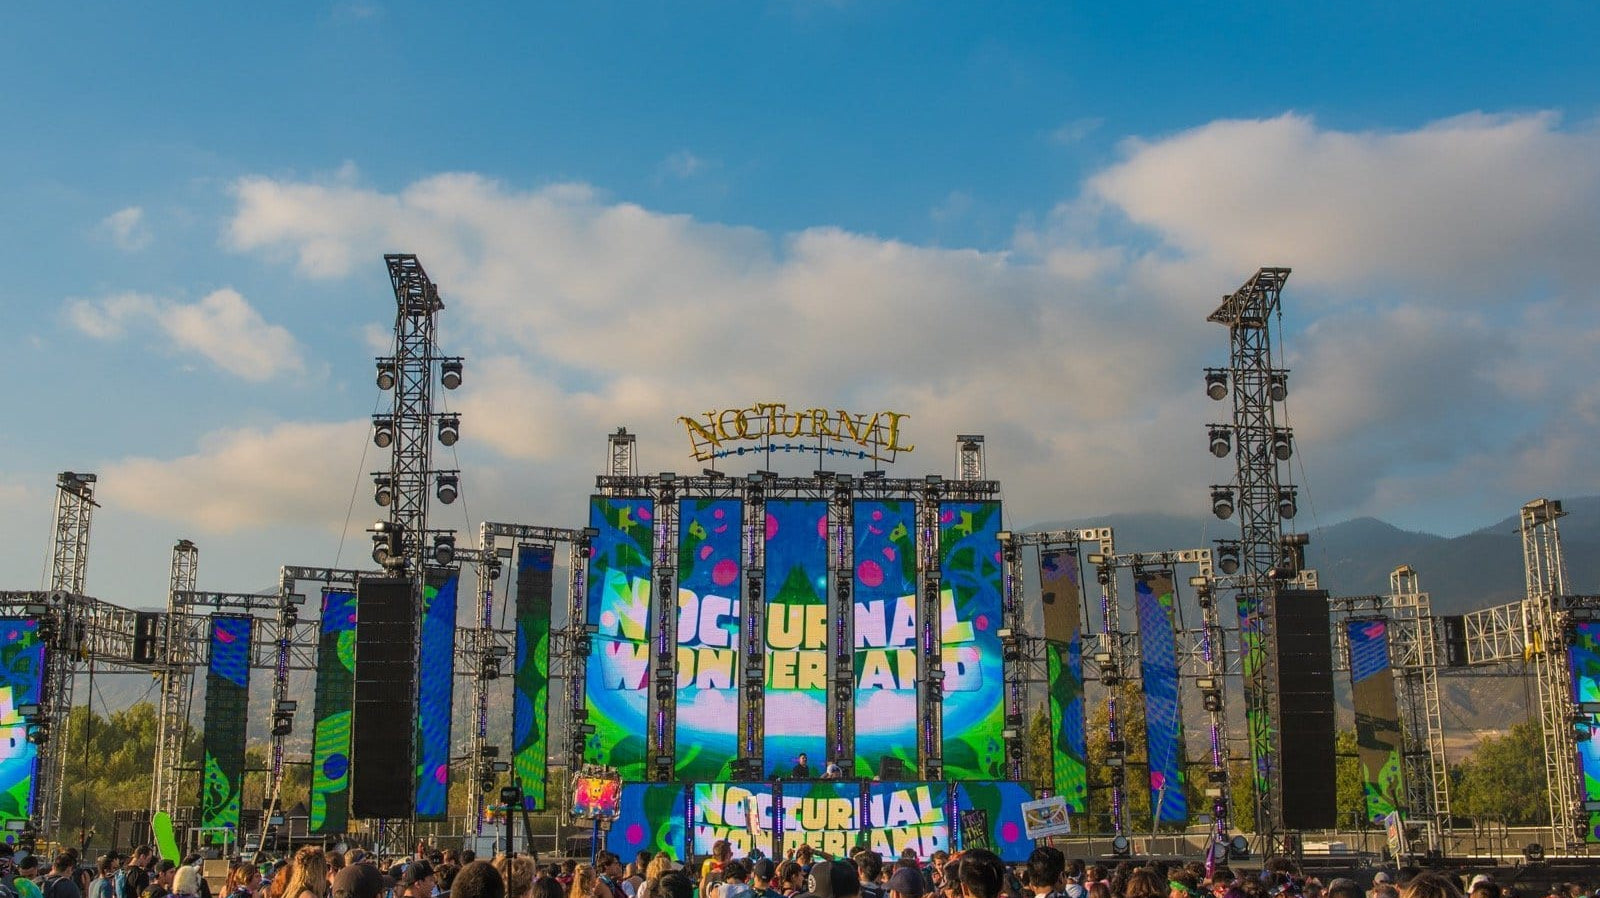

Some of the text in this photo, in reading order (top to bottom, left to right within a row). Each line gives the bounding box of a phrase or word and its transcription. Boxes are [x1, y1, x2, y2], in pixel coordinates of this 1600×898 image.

[677, 402, 914, 458] NOCTURNAL
[717, 443, 866, 460] WONDERLAND
[599, 640, 984, 691] WONERAND
[694, 783, 945, 830] NOCTURNAL
